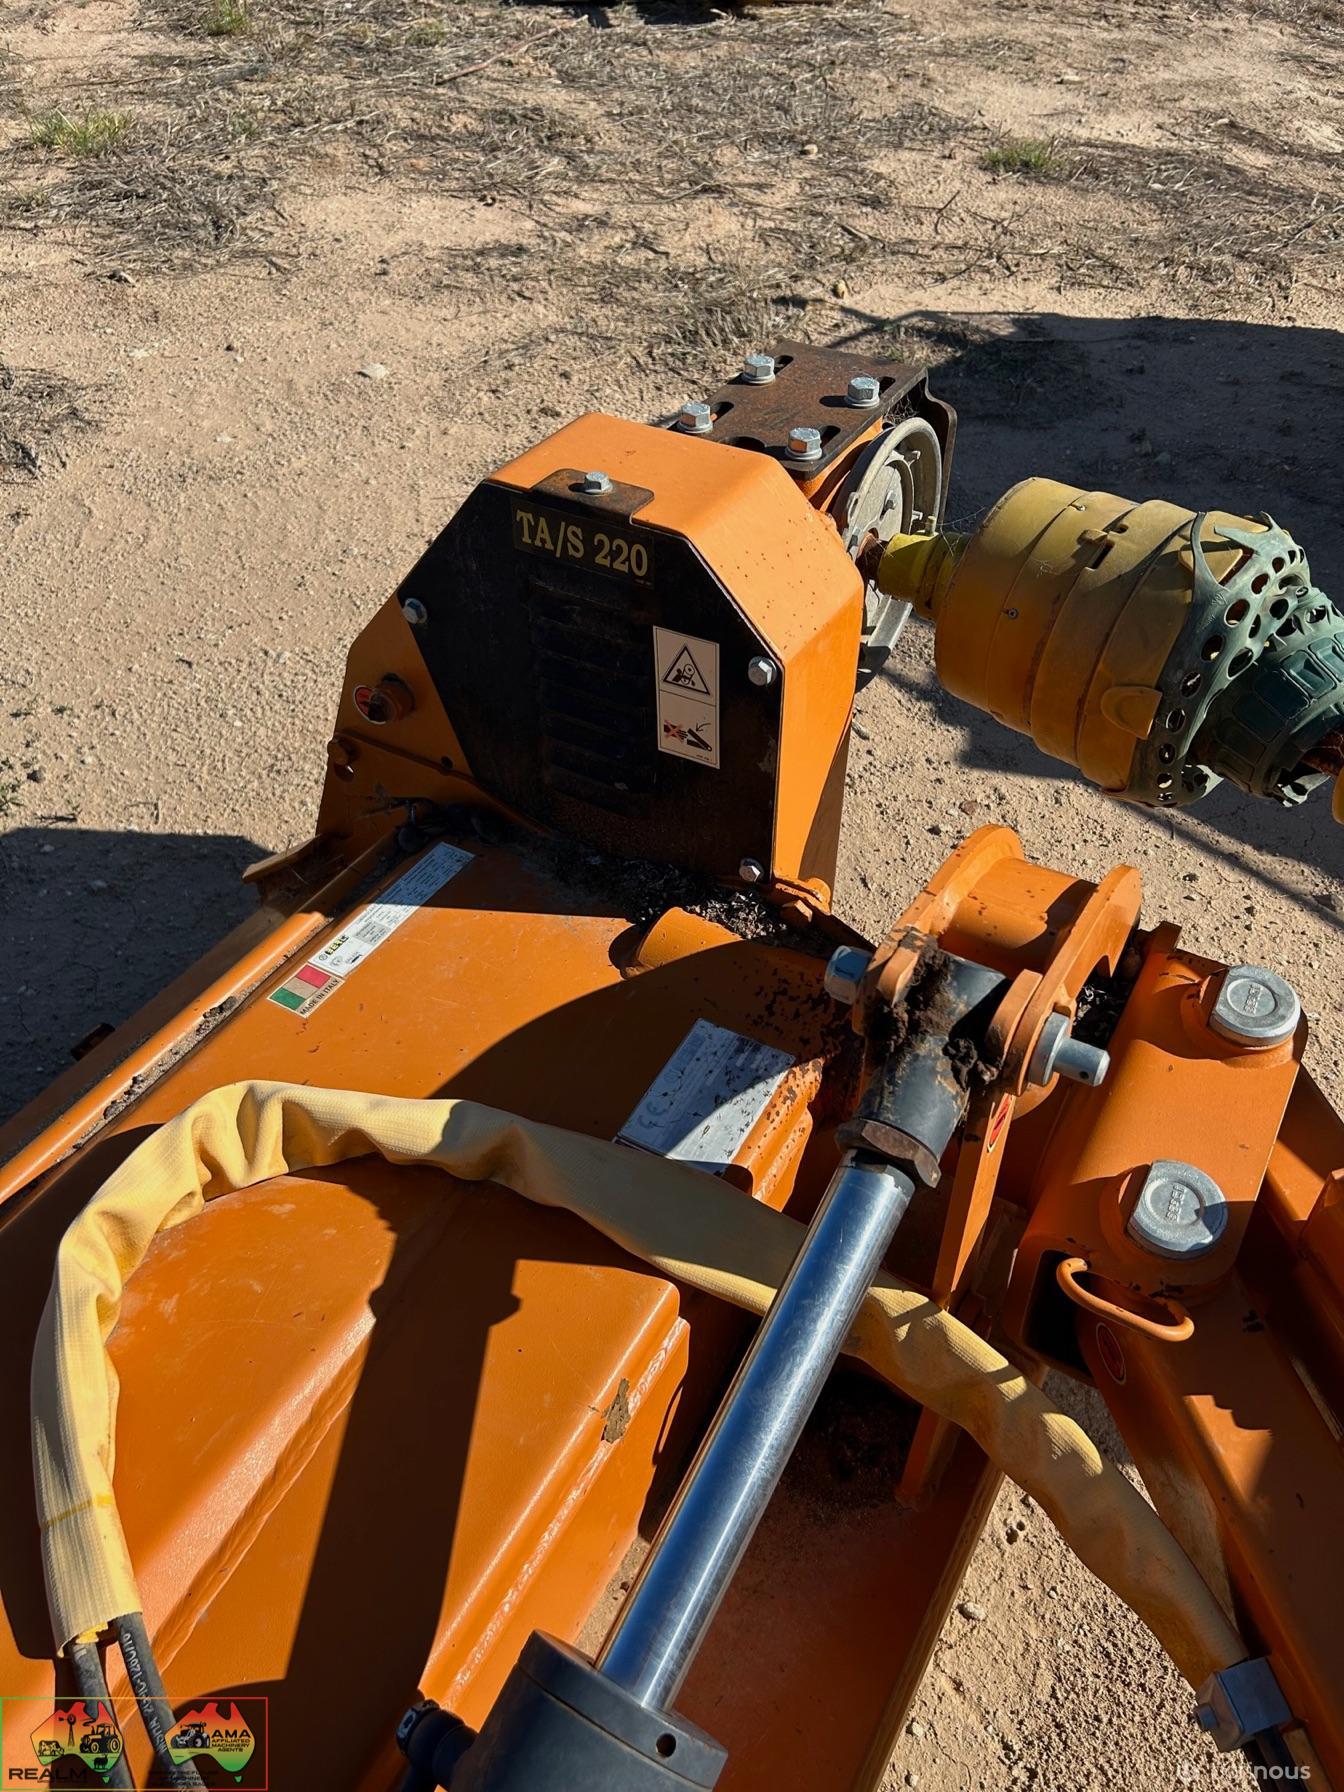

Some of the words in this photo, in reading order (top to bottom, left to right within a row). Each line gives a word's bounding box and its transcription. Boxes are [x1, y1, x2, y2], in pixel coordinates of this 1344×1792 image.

[516, 511, 584, 558] TA/S
[593, 533, 648, 577] 220
[300, 1000, 317, 1015] MADE
[324, 979, 340, 994] ITALY
